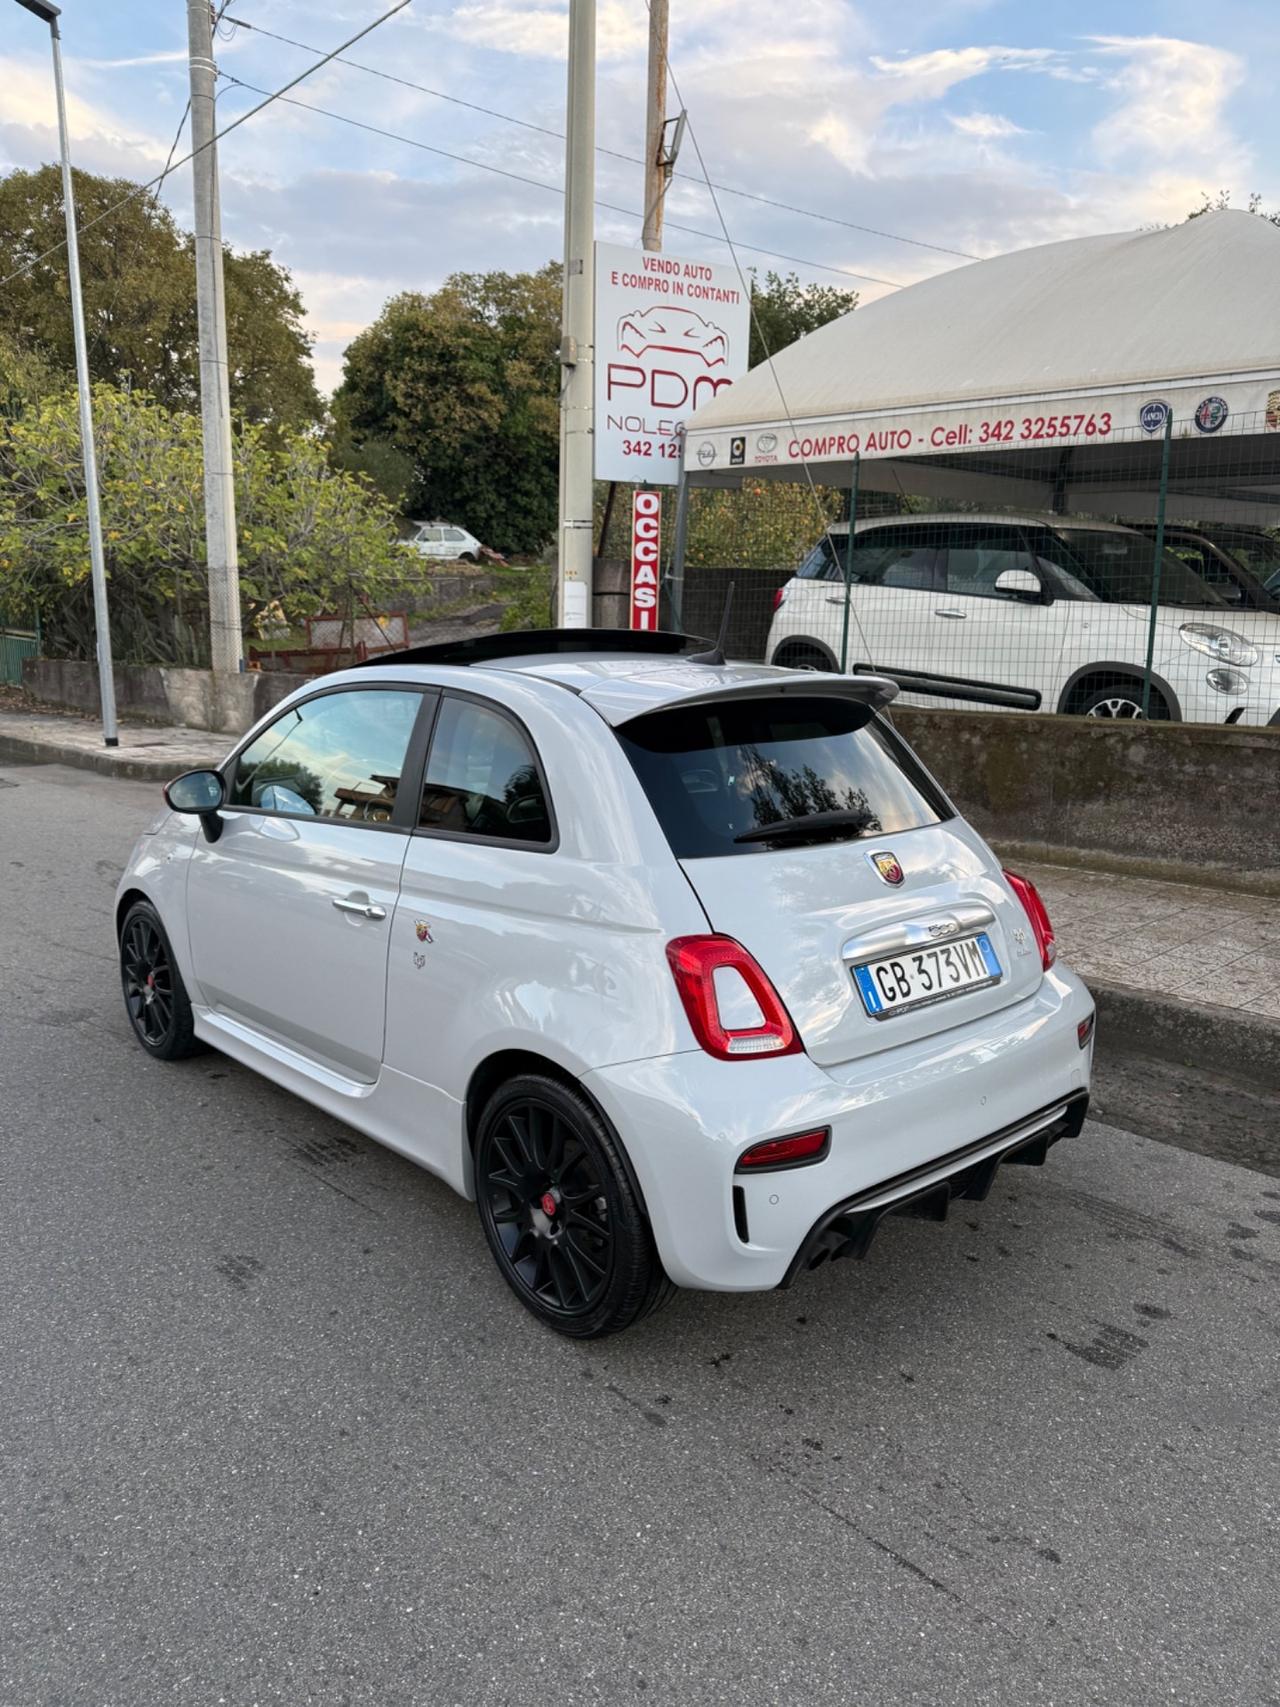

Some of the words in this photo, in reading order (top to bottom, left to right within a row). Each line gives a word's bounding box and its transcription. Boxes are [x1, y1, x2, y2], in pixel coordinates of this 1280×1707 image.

[642, 256, 681, 276] VENDO
[683, 264, 713, 281] AUTO
[611, 271, 619, 285] E
[621, 273, 670, 293] COMPRO
[672, 280, 684, 296] IN
[687, 283, 740, 304] CONTANTI
[622, 439, 653, 456] 342
[788, 433, 860, 458] COMPRO
[865, 429, 912, 451] AUTO
[930, 422, 973, 447] Cell:
[979, 419, 1015, 443] 342
[1020, 412, 1112, 440] 3255763
[875, 961, 912, 1002] GB
[912, 940, 988, 991] 373VM
